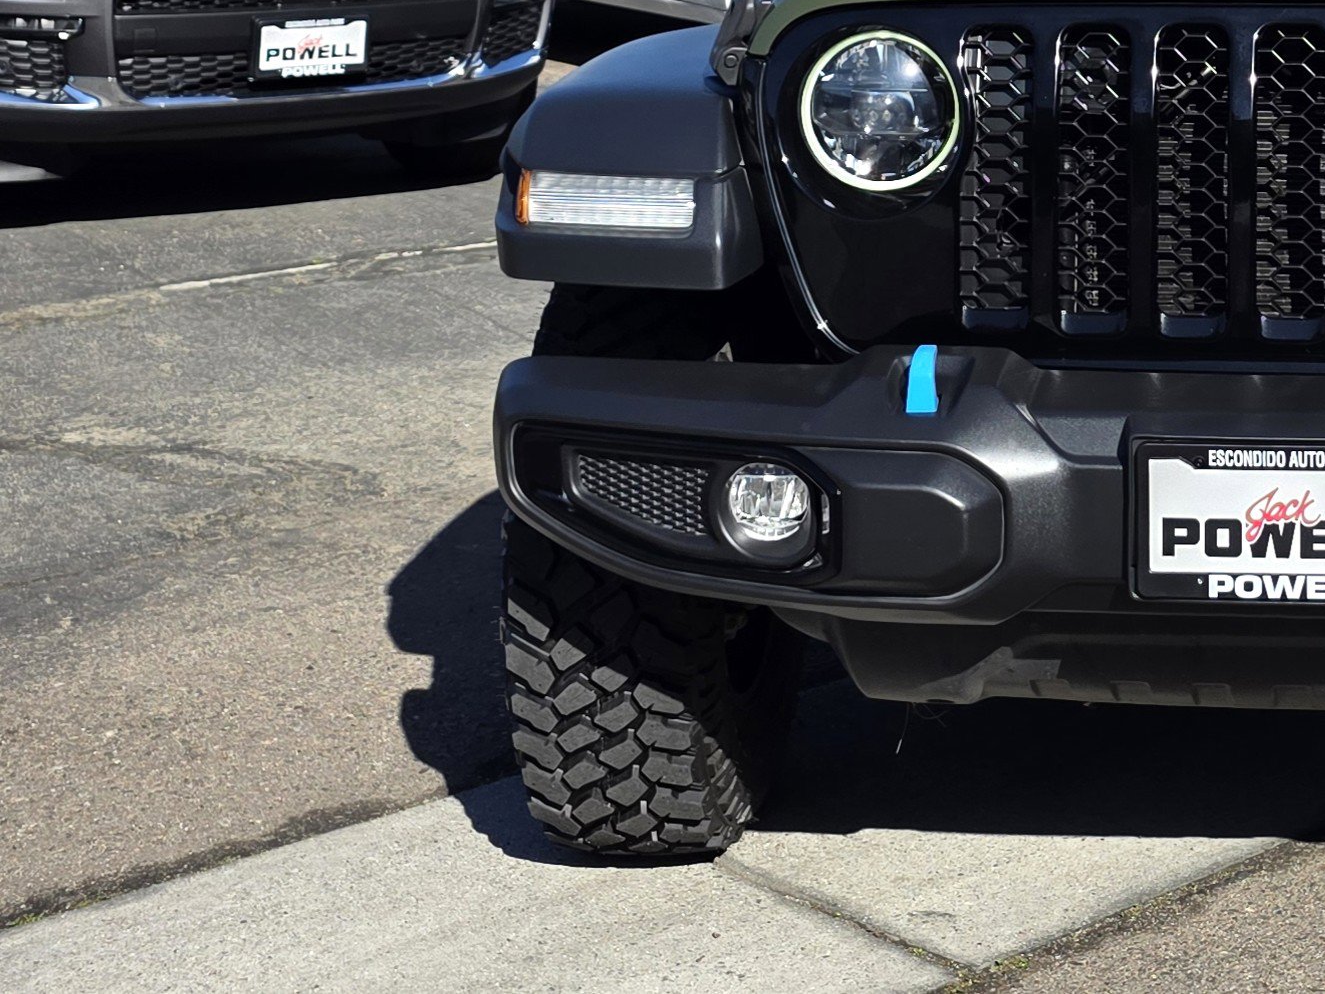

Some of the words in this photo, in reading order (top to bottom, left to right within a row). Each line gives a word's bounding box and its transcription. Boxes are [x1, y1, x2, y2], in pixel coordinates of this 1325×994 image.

[266, 43, 357, 62] POWELL
[1208, 449, 1287, 468] ESCONDIDO
[1288, 450, 1325, 468] AUTO
[1245, 487, 1321, 542] Jack
